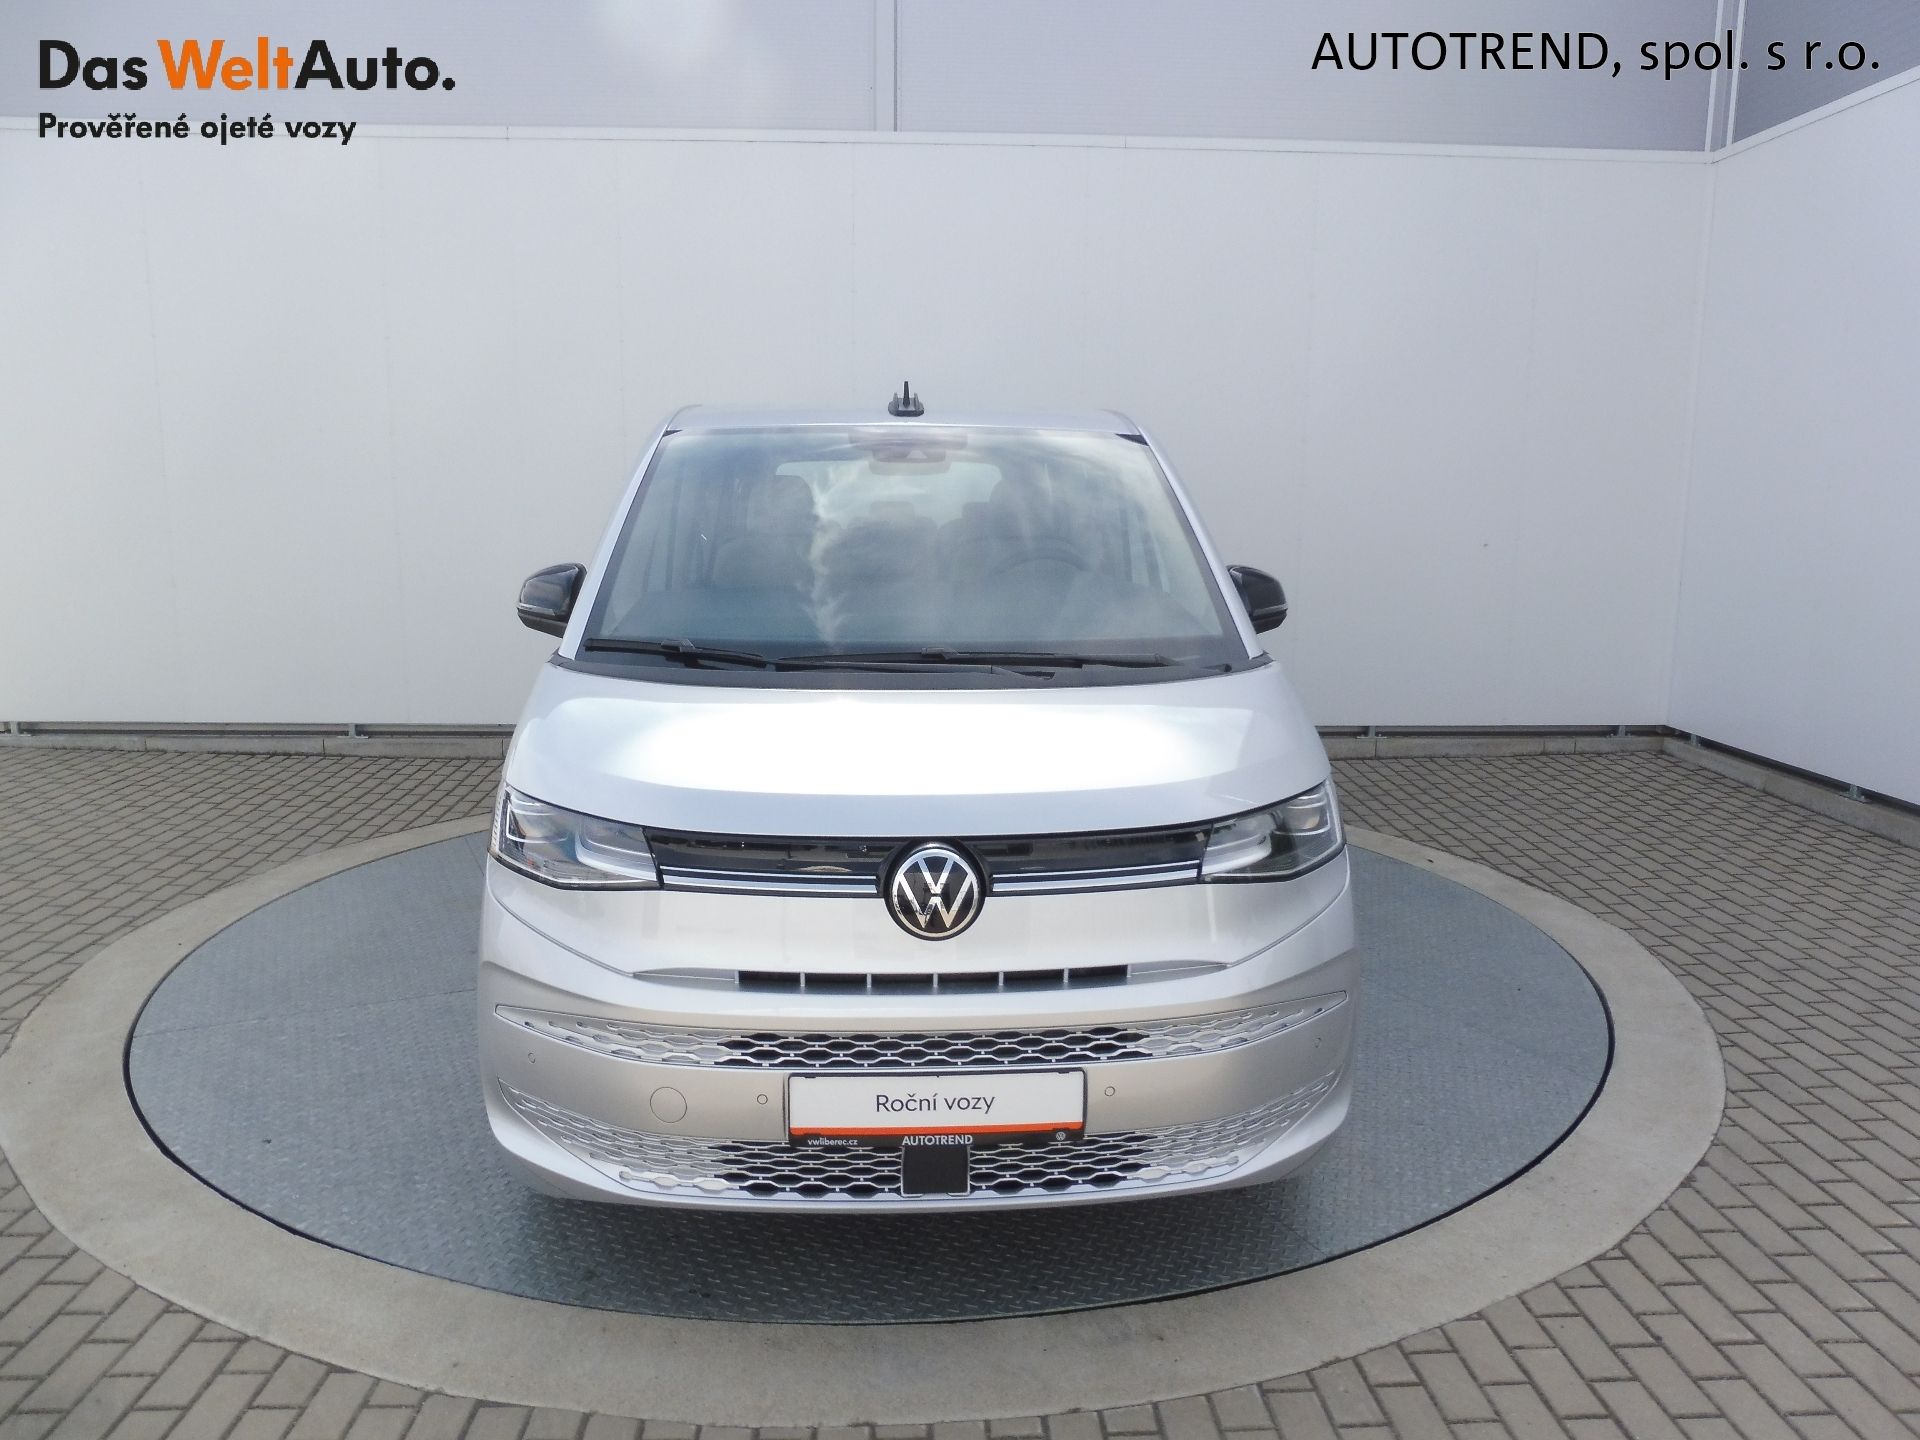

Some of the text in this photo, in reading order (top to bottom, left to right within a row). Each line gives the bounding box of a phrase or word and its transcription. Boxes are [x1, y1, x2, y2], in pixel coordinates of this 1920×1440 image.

[876, 1093, 996, 1115] Roční vozy
[807, 1136, 859, 1146] vwliberec.cz
[901, 1134, 974, 1146] AUTOTREND
